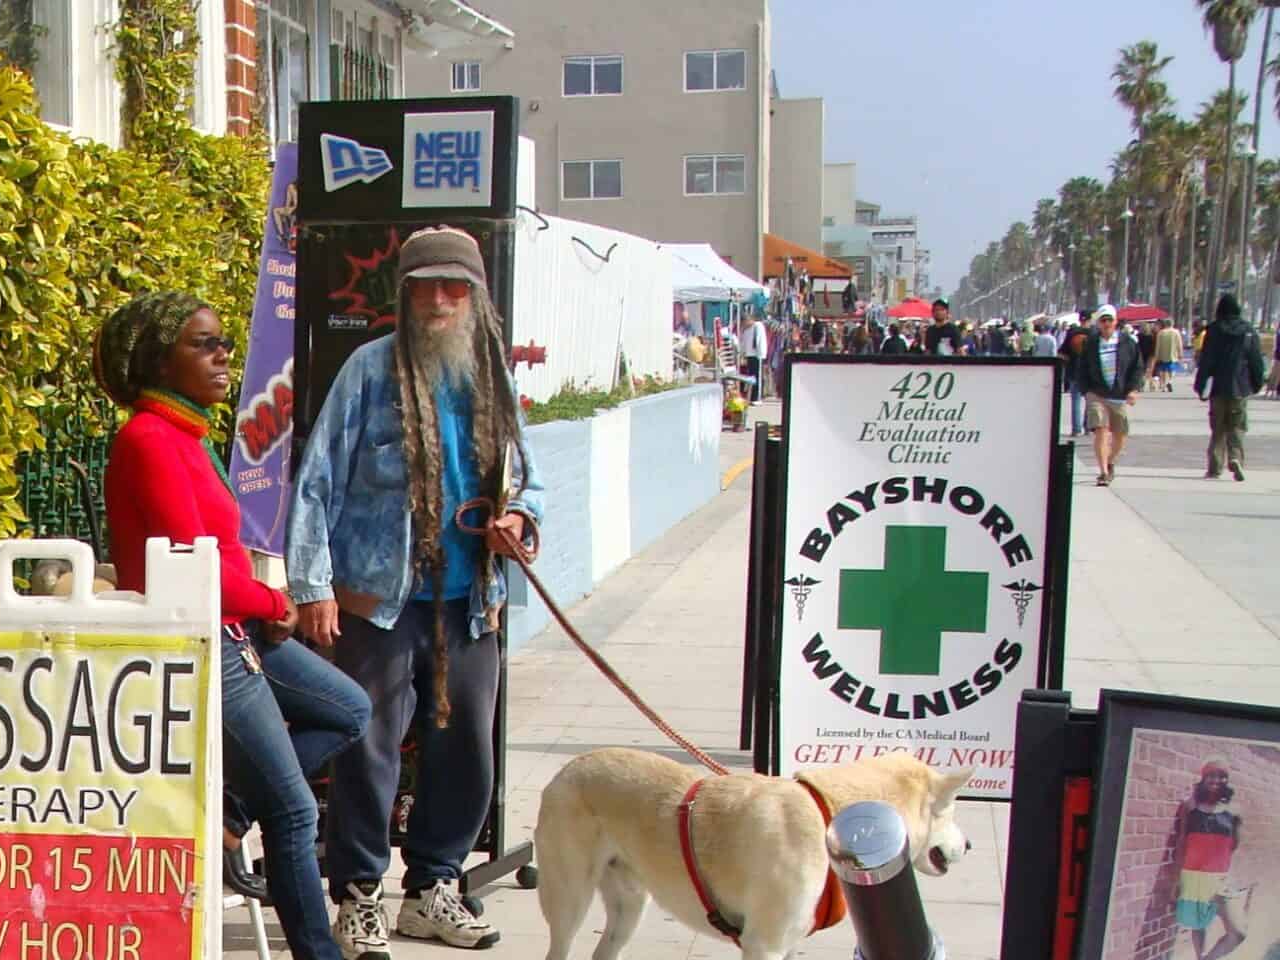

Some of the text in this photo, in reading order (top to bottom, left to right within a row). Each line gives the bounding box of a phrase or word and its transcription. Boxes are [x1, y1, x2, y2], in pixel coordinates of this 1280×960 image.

[414, 131, 481, 161] NEW
[414, 160, 481, 188] ERA
[889, 370, 955, 401] 420
[876, 401, 968, 422] Medical
[856, 421, 982, 443] Evaluation
[887, 443, 952, 464] Clinic
[799, 476, 1033, 569] BAYSHORE
[801, 631, 1023, 720] WELLNESS
[816, 728, 990, 742] Licensed by the CA Medical Board
[795, 744, 850, 764] GET
[48, 847, 93, 892] 15
[106, 847, 188, 896] MIN
